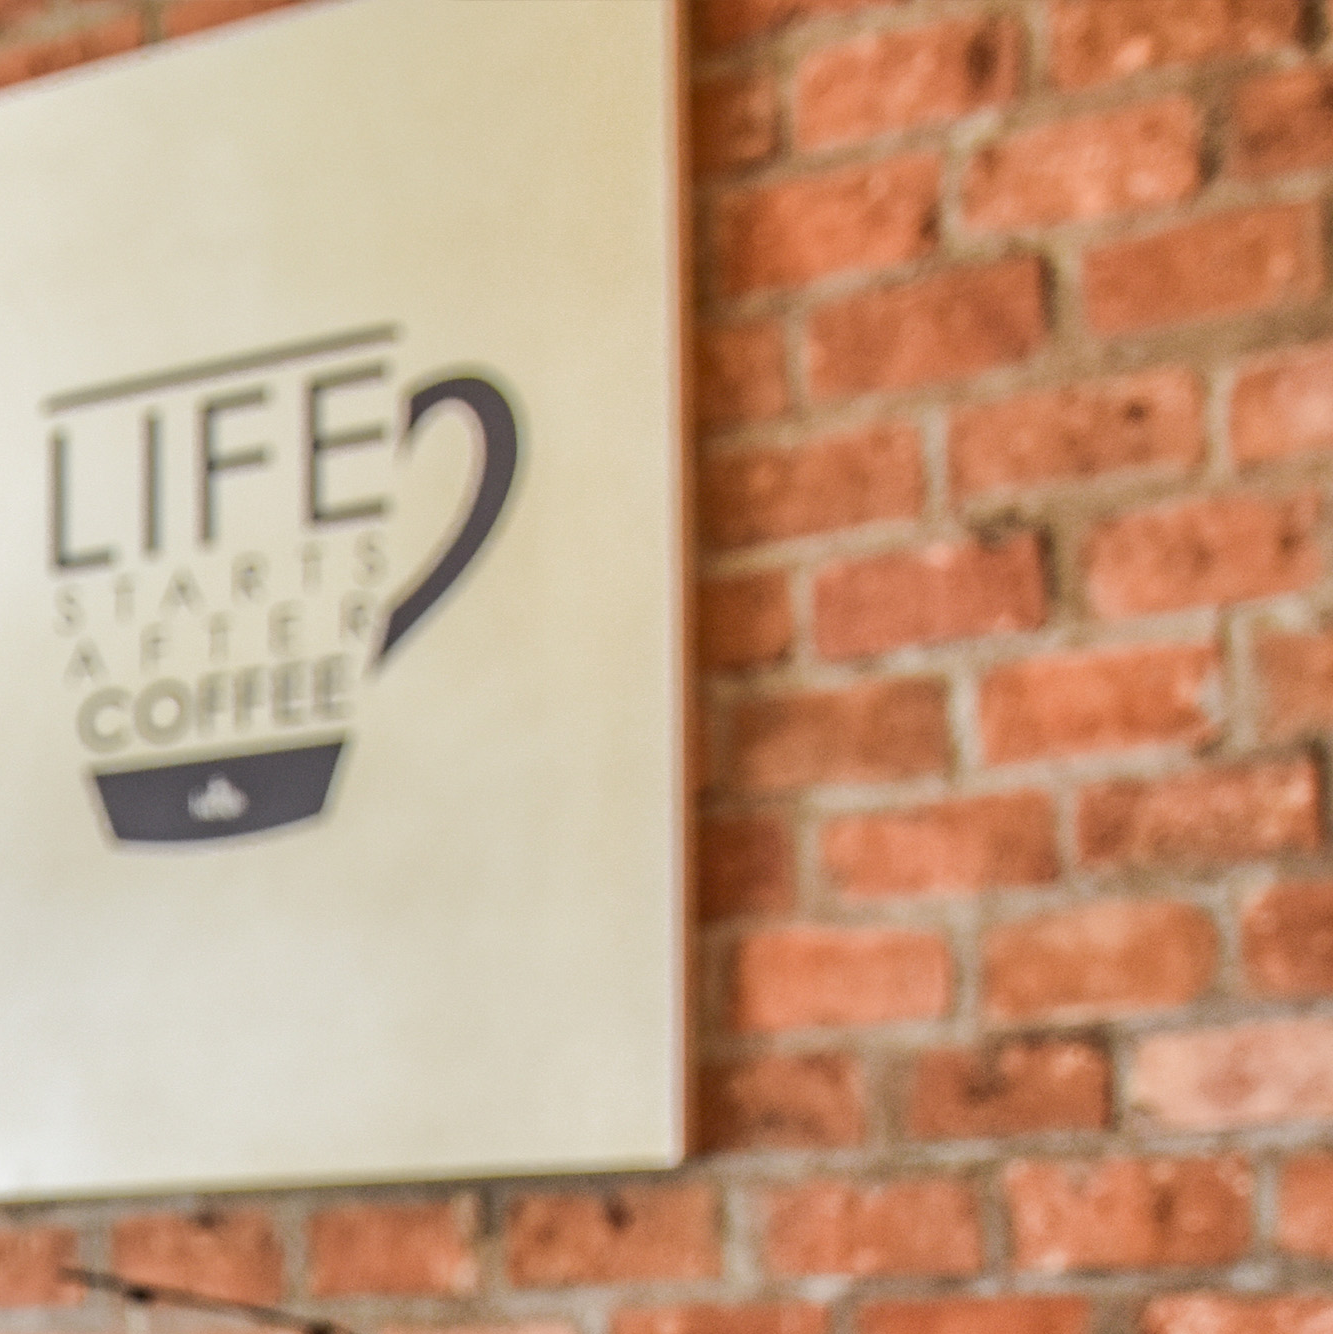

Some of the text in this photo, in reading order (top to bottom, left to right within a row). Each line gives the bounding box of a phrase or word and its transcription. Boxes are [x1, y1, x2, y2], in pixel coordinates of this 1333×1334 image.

[47, 358, 390, 573] LIFE
[52, 533, 387, 638] STARTS
[64, 590, 371, 688] AFTER
[77, 654, 351, 751] COFFEE
